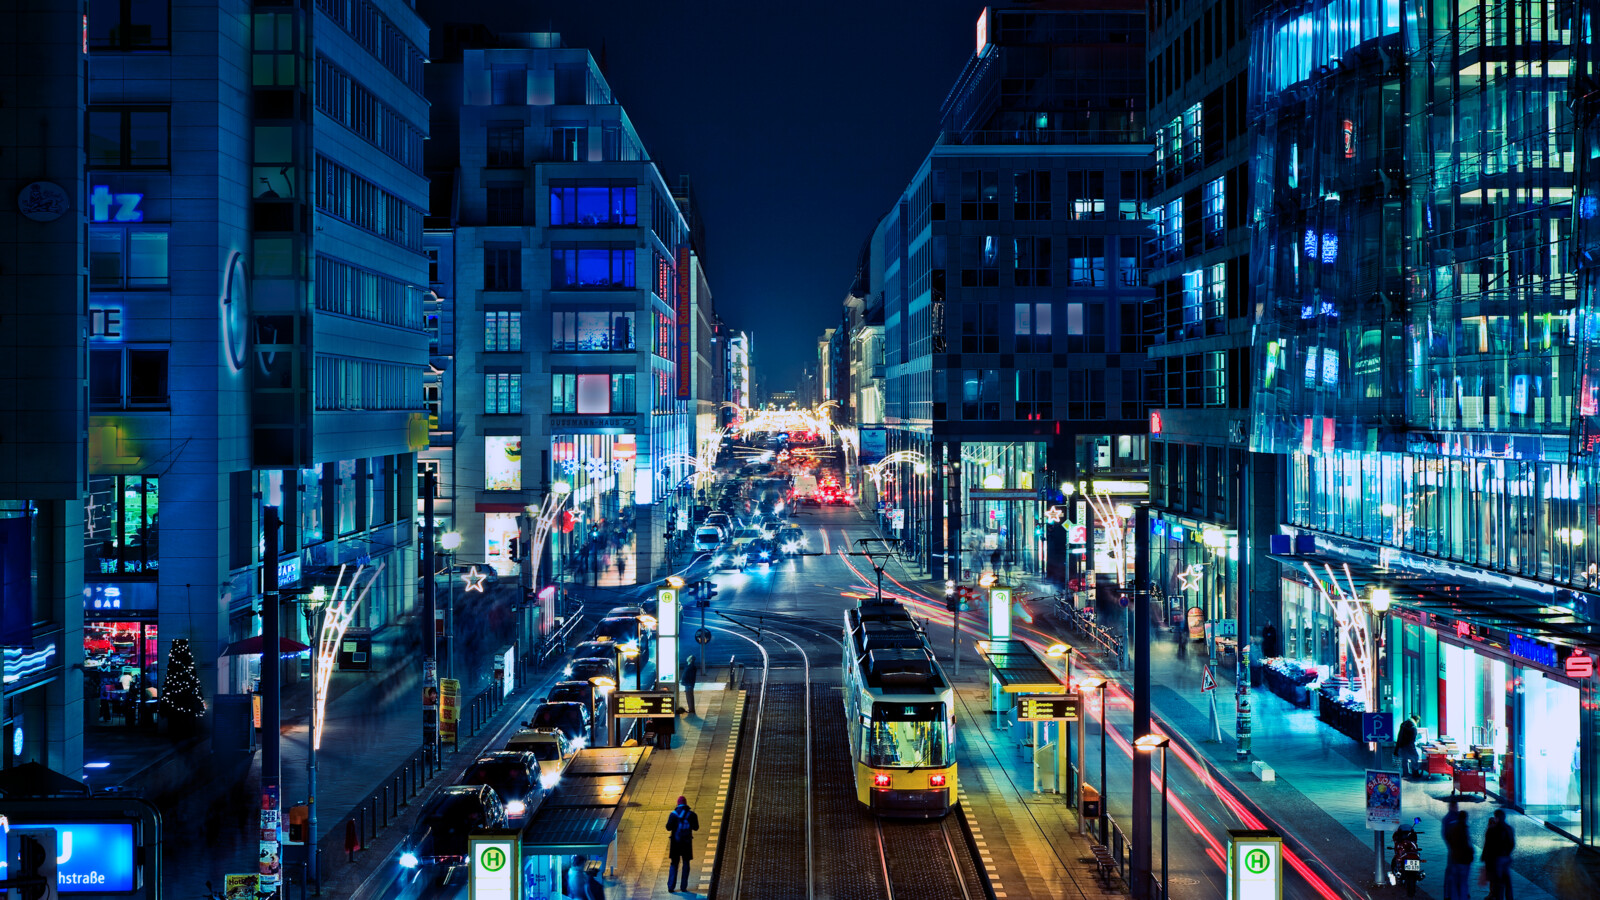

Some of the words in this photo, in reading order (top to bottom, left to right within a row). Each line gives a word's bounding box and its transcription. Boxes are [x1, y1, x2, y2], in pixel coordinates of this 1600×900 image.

[91, 185, 143, 222] tz
[679, 346, 688, 397] Dussmann
[1373, 720, 1383, 735] P
[58, 871, 105, 884] hstraße
